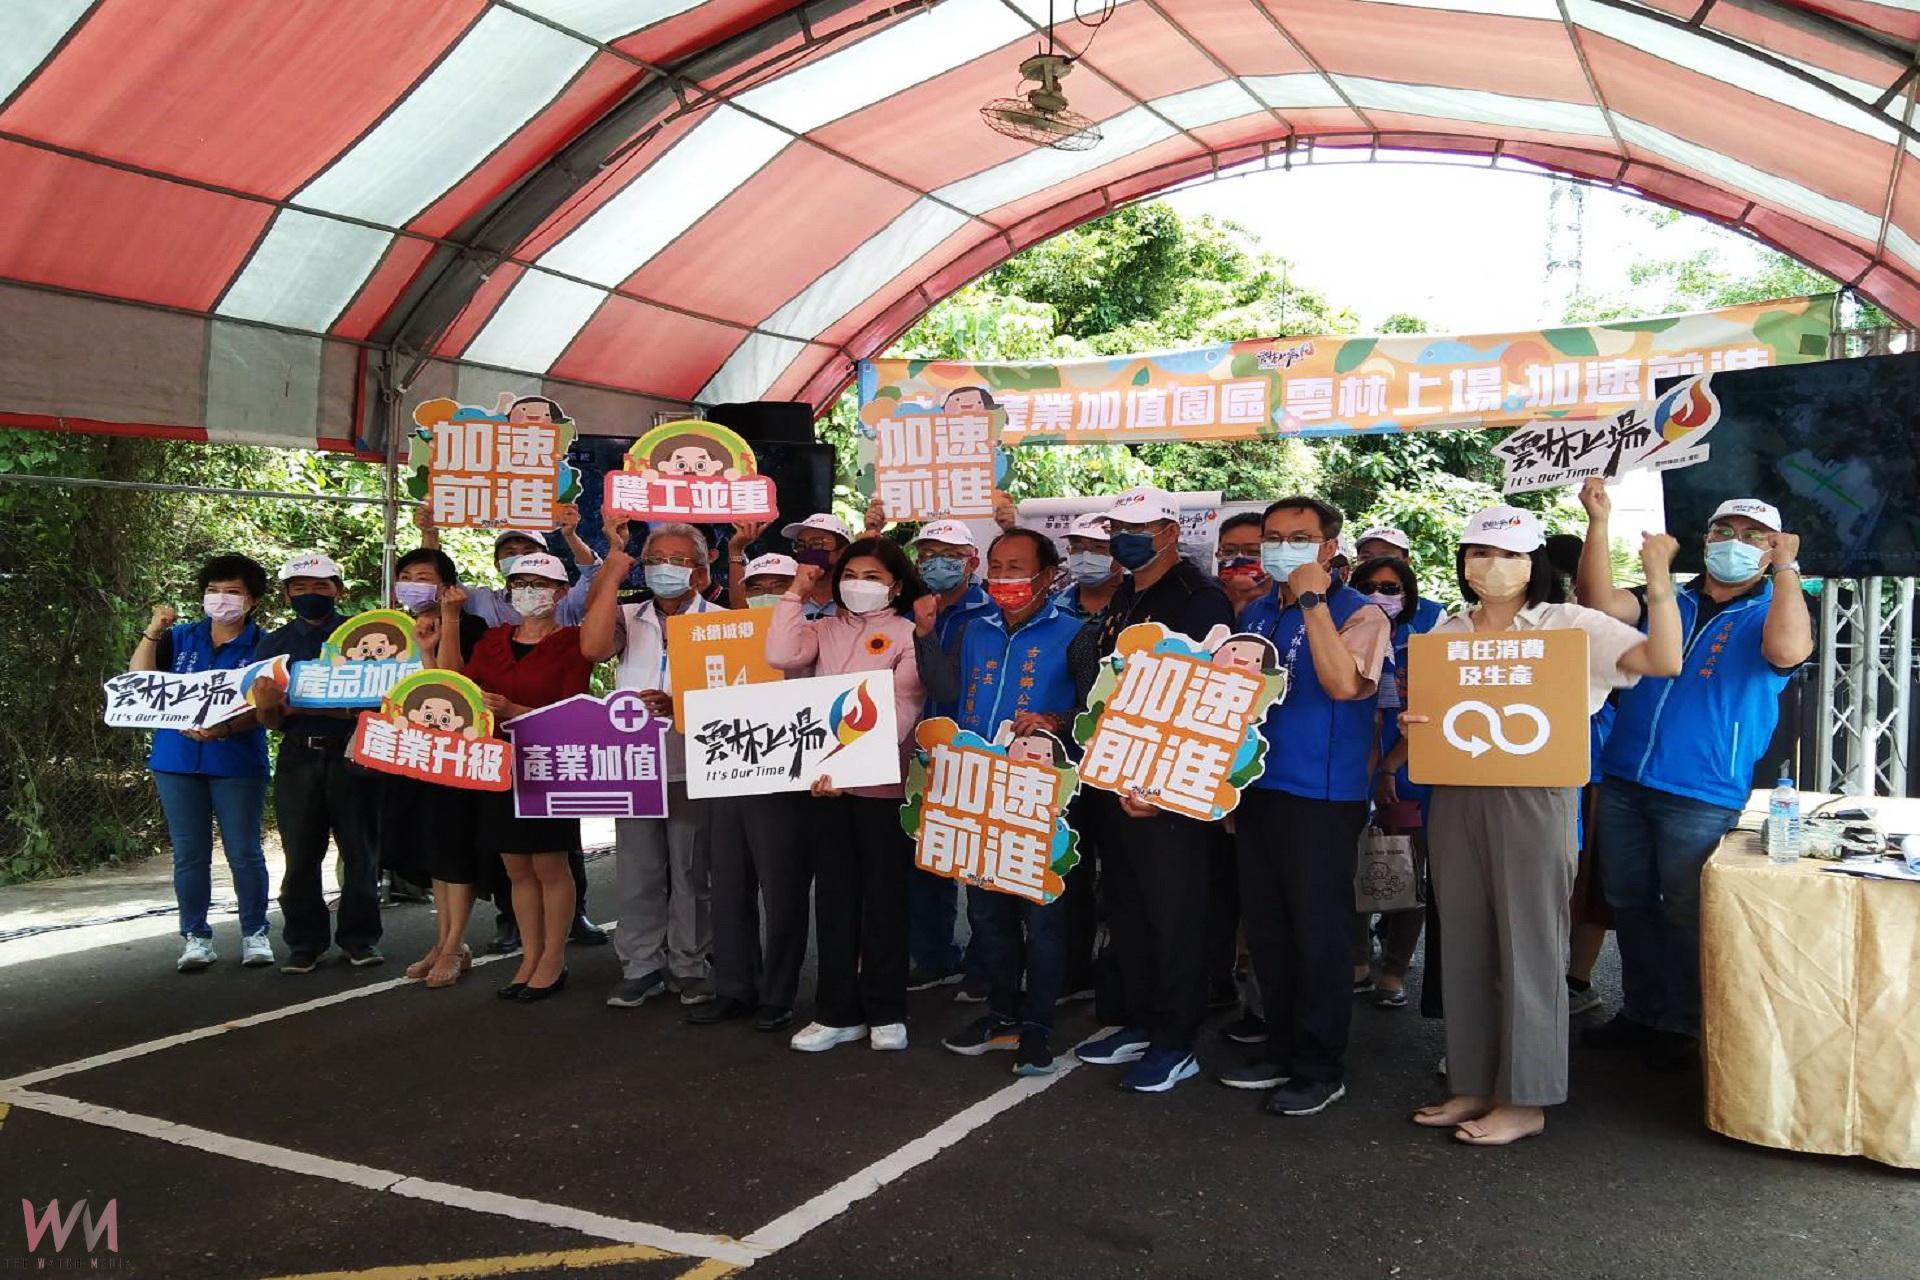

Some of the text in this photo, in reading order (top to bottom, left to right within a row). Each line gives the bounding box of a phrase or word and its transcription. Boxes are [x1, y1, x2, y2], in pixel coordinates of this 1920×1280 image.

[902, 381, 1266, 432] 產業加值園區
[1285, 366, 1502, 420] 雲林上場
[432, 421, 556, 475] 加速
[876, 415, 992, 467] 加速
[1501, 409, 1651, 479] 雲林上場
[432, 474, 553, 527] 前進
[611, 475, 770, 515] 農工並重
[879, 467, 994, 519] 前進
[1510, 467, 1600, 488] It's Our Time
[1447, 638, 1545, 661] 責任消費
[1459, 665, 1534, 686] 及生產
[107, 672, 237, 727] 雲林上場
[110, 713, 190, 722] It's Our Time
[1109, 649, 1260, 744] 加速
[361, 716, 504, 783] 產業升級
[522, 744, 659, 781] 產業加值
[694, 706, 827, 783] 雲林上場
[1084, 716, 1231, 814] 前進
[706, 765, 785, 782] It's Our Time
[927, 744, 1057, 834] 加速
[921, 809, 1047, 900] 前進
